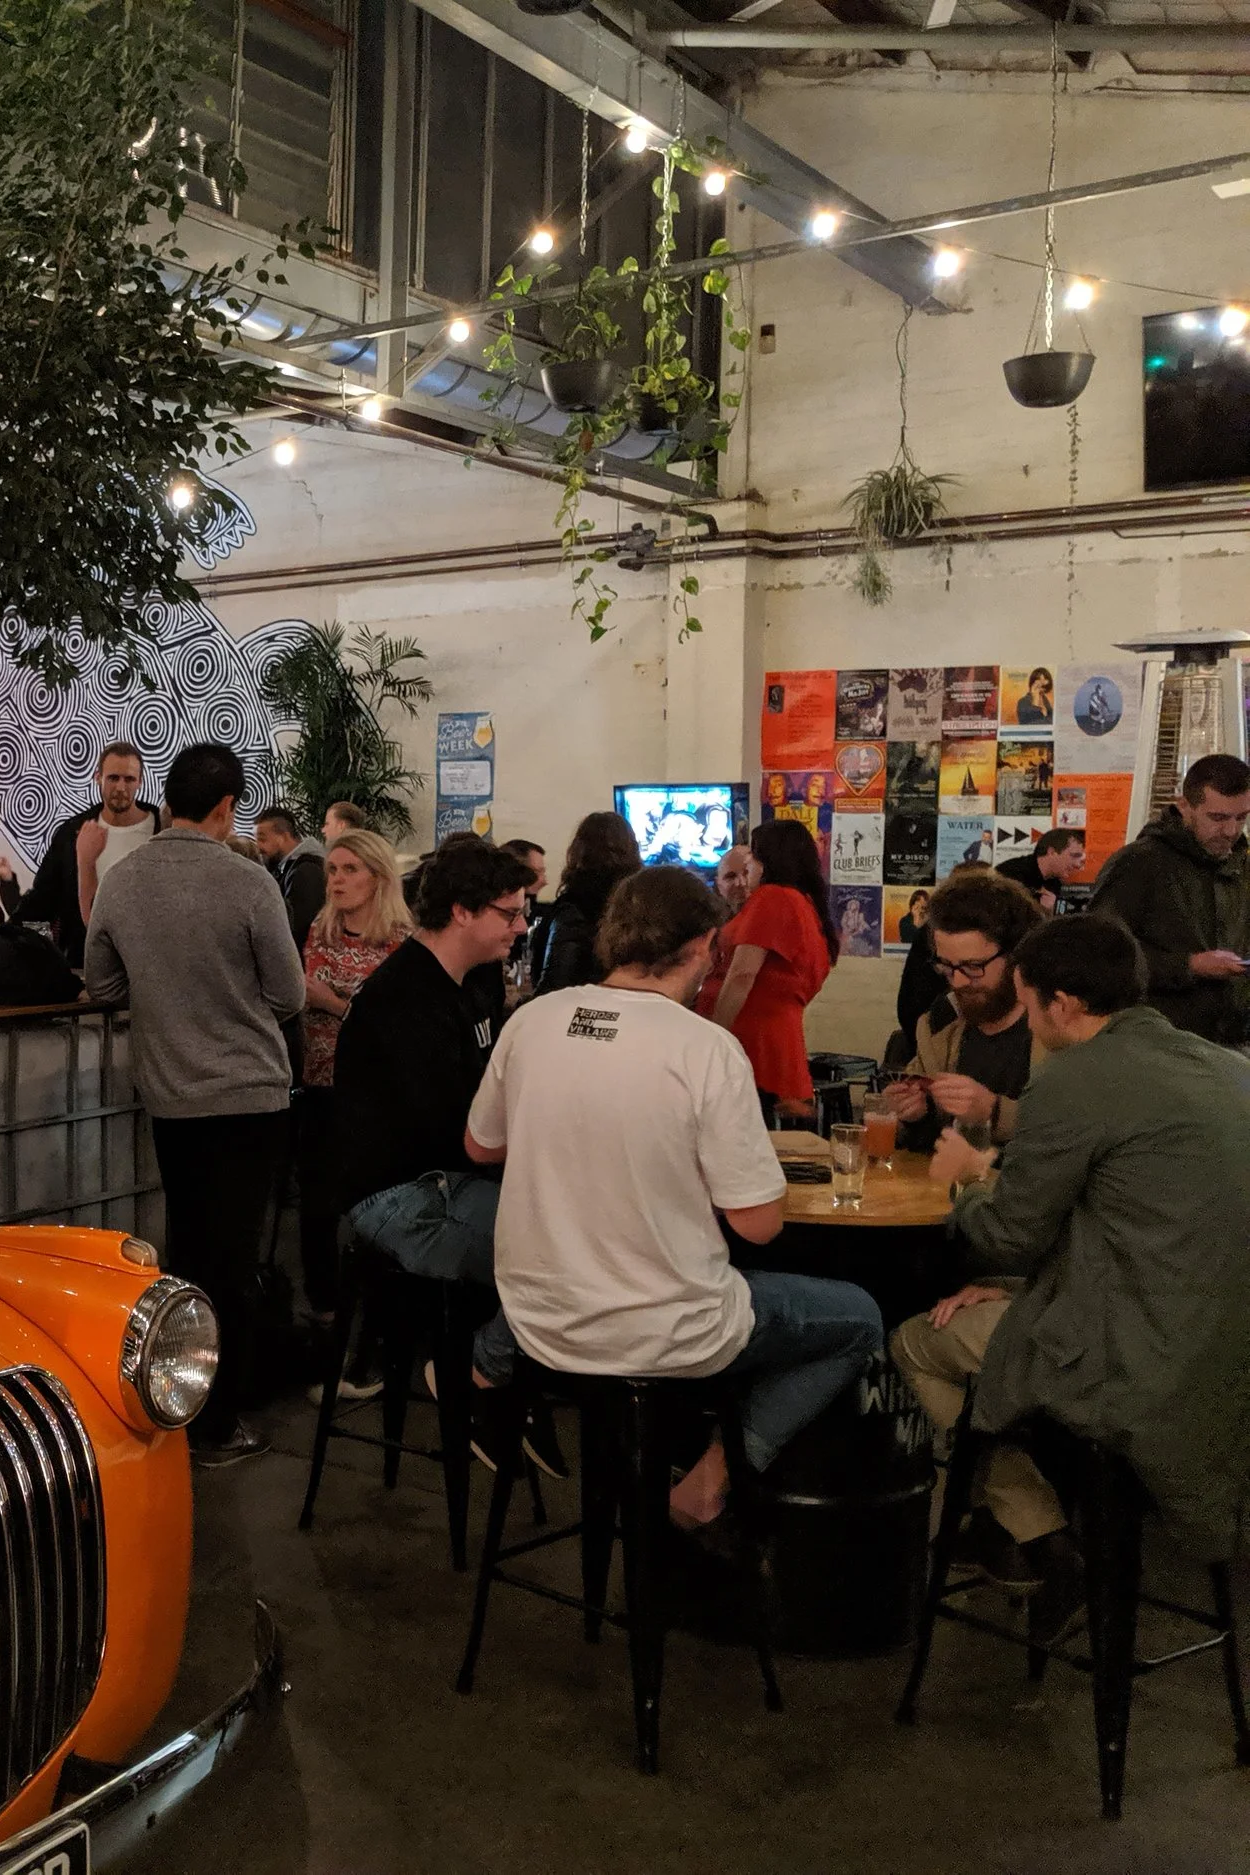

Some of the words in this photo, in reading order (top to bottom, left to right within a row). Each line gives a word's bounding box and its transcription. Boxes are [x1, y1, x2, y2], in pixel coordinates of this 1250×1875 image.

[438, 739, 474, 753] WEEK
[947, 821, 983, 830] WATER
[833, 859, 852, 870] CLUB
[854, 855, 881, 868] BRIEFS
[576, 1008, 620, 1021] HEROES
[572, 1016, 595, 1027] AND
